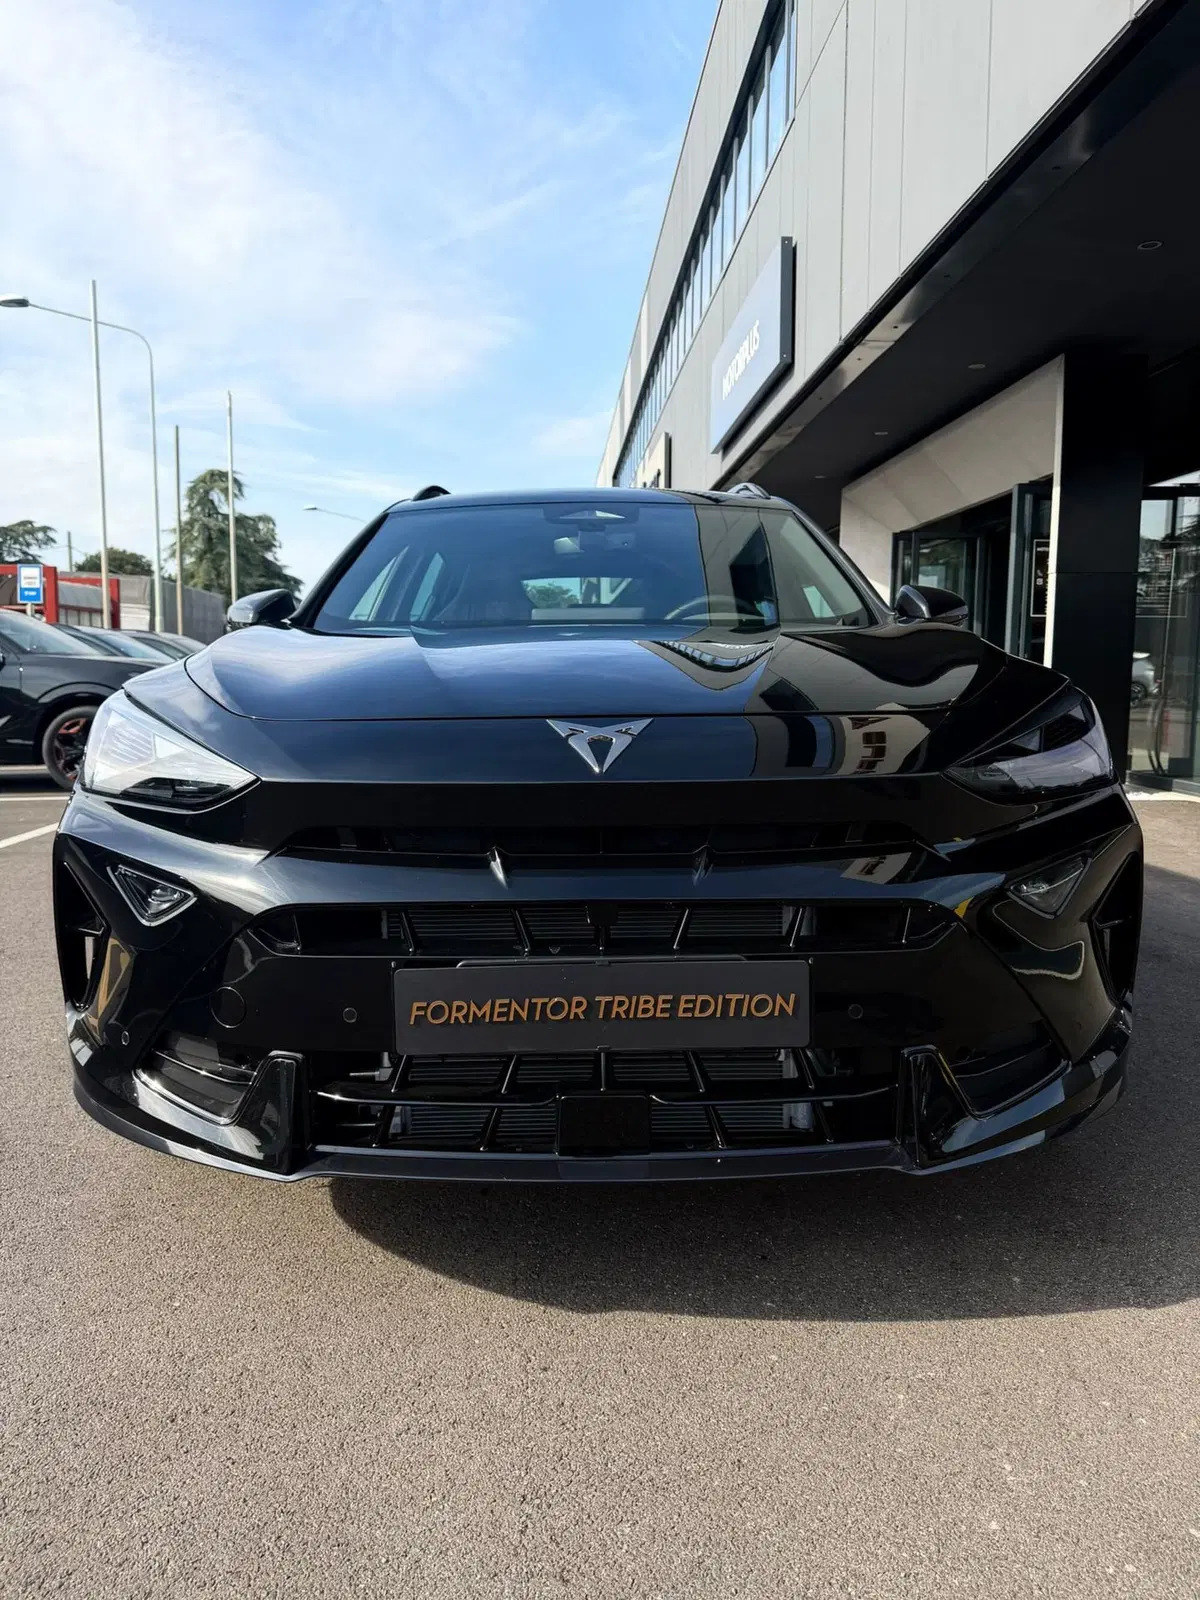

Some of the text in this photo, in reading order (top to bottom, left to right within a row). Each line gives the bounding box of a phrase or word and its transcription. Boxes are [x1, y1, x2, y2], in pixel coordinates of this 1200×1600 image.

[409, 993, 796, 1024] FORMENTOR TRIBE EDITION
